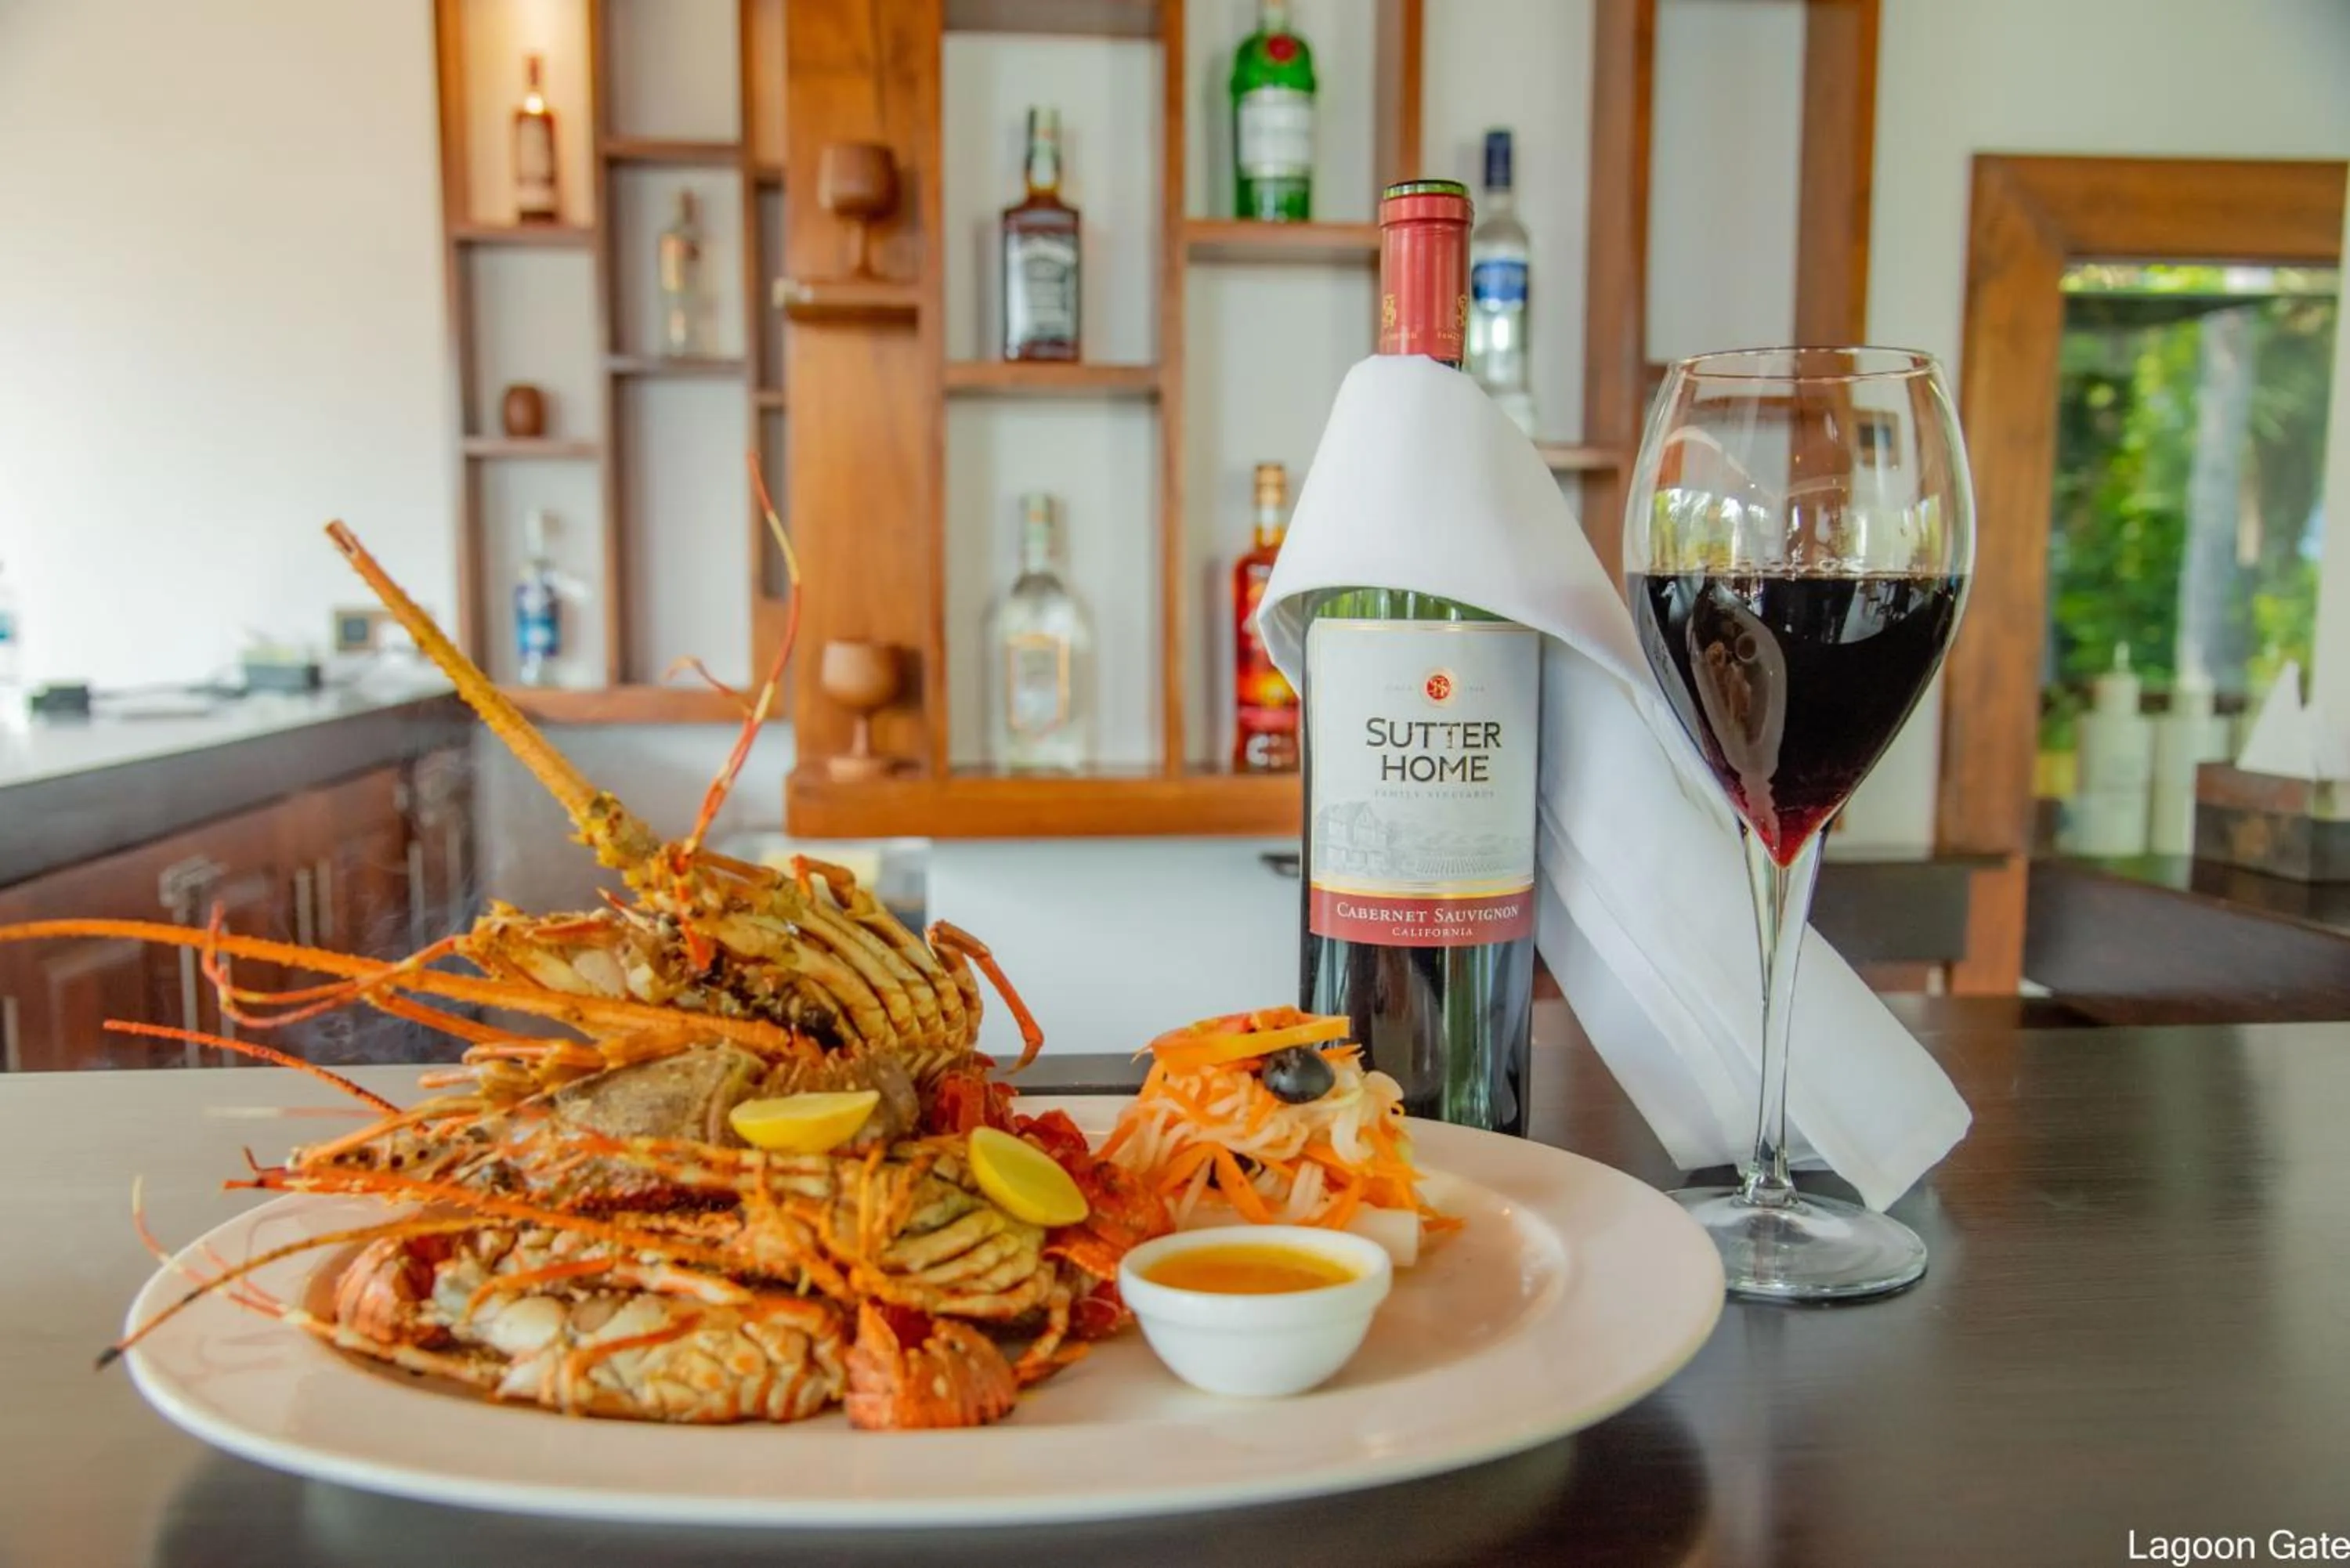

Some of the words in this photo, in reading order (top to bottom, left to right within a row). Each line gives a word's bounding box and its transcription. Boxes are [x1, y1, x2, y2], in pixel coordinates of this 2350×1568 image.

[1365, 717, 1502, 749] SUTTER
[1381, 754, 1490, 782] HOME
[1336, 901, 1427, 923] CABERNET
[1434, 905, 1520, 923] SAUVIGNON
[1391, 927, 1473, 938] CALIFORNIA
